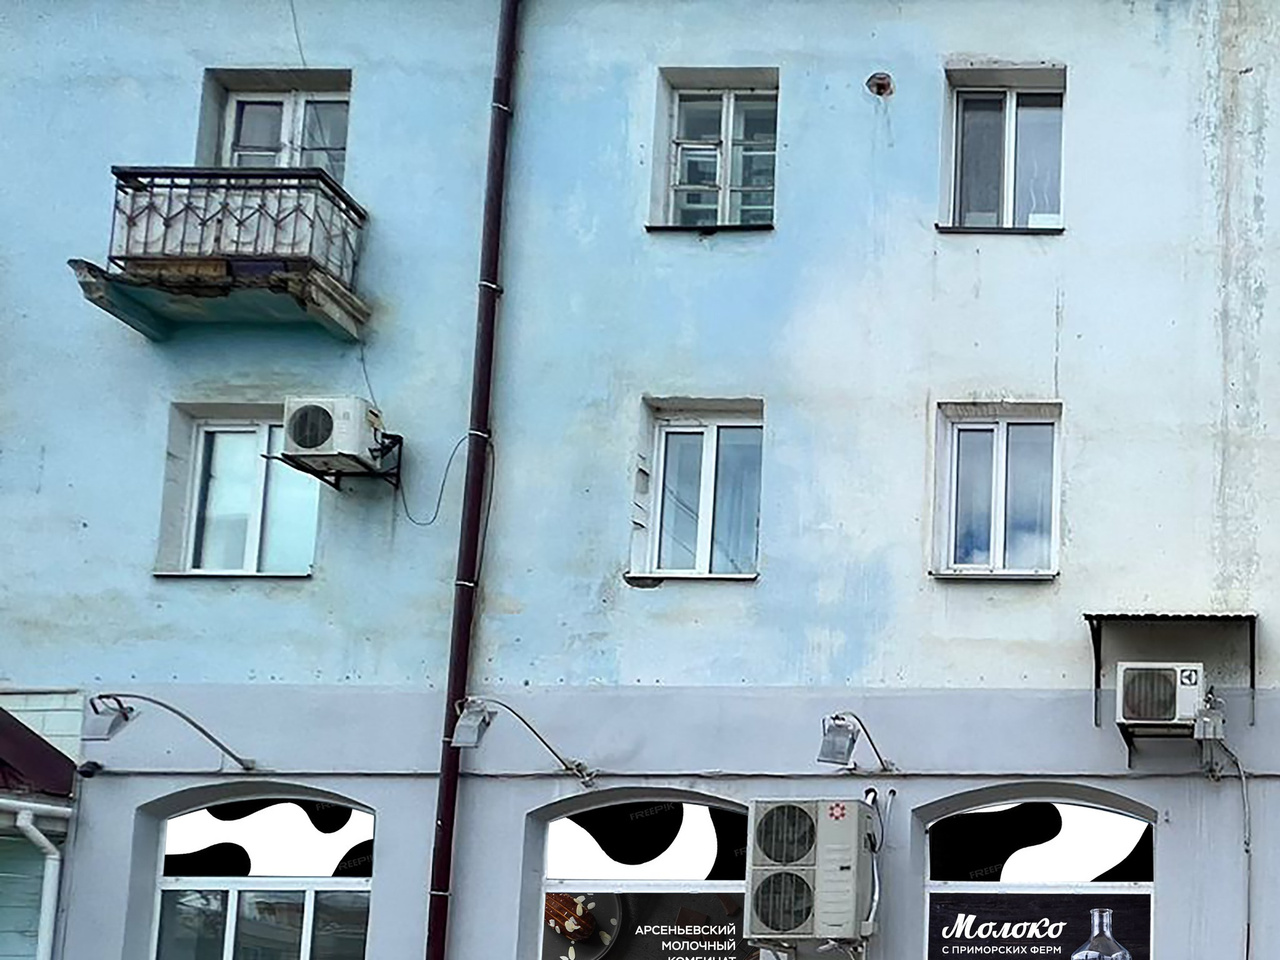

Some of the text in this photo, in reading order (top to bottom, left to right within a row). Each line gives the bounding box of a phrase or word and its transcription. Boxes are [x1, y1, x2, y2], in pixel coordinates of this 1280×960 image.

[634, 922, 736, 935] АРСЕНЬЕВСКИЙ
[941, 913, 1068, 939] Молоко
[661, 938, 736, 951] МОЛОЧНЫЙ
[941, 945, 1062, 955] С ПРИМОРСКИХ ФЕРМ
